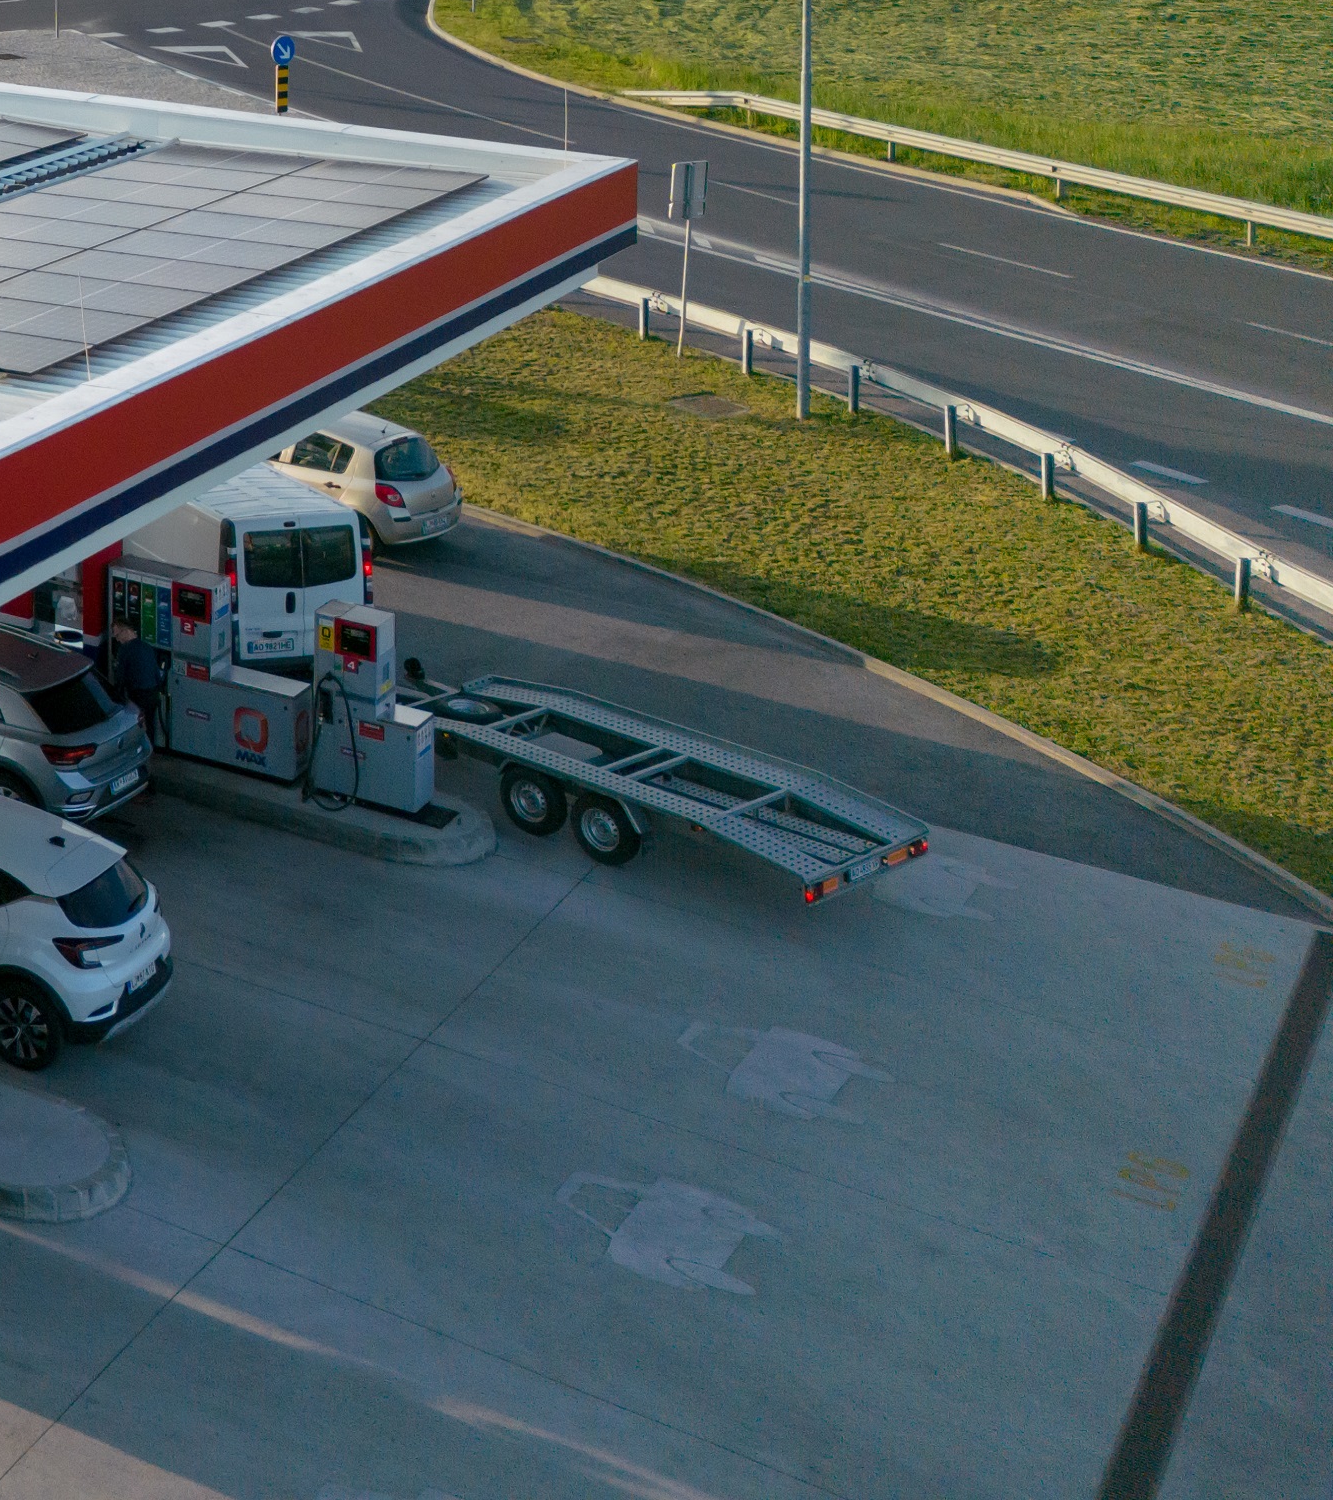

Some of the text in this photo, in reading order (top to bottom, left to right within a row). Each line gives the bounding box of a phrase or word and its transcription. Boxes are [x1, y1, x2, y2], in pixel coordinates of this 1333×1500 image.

[183, 622, 192, 632] 2
[347, 660, 355, 670] 4
[235, 750, 267, 767] MAX
